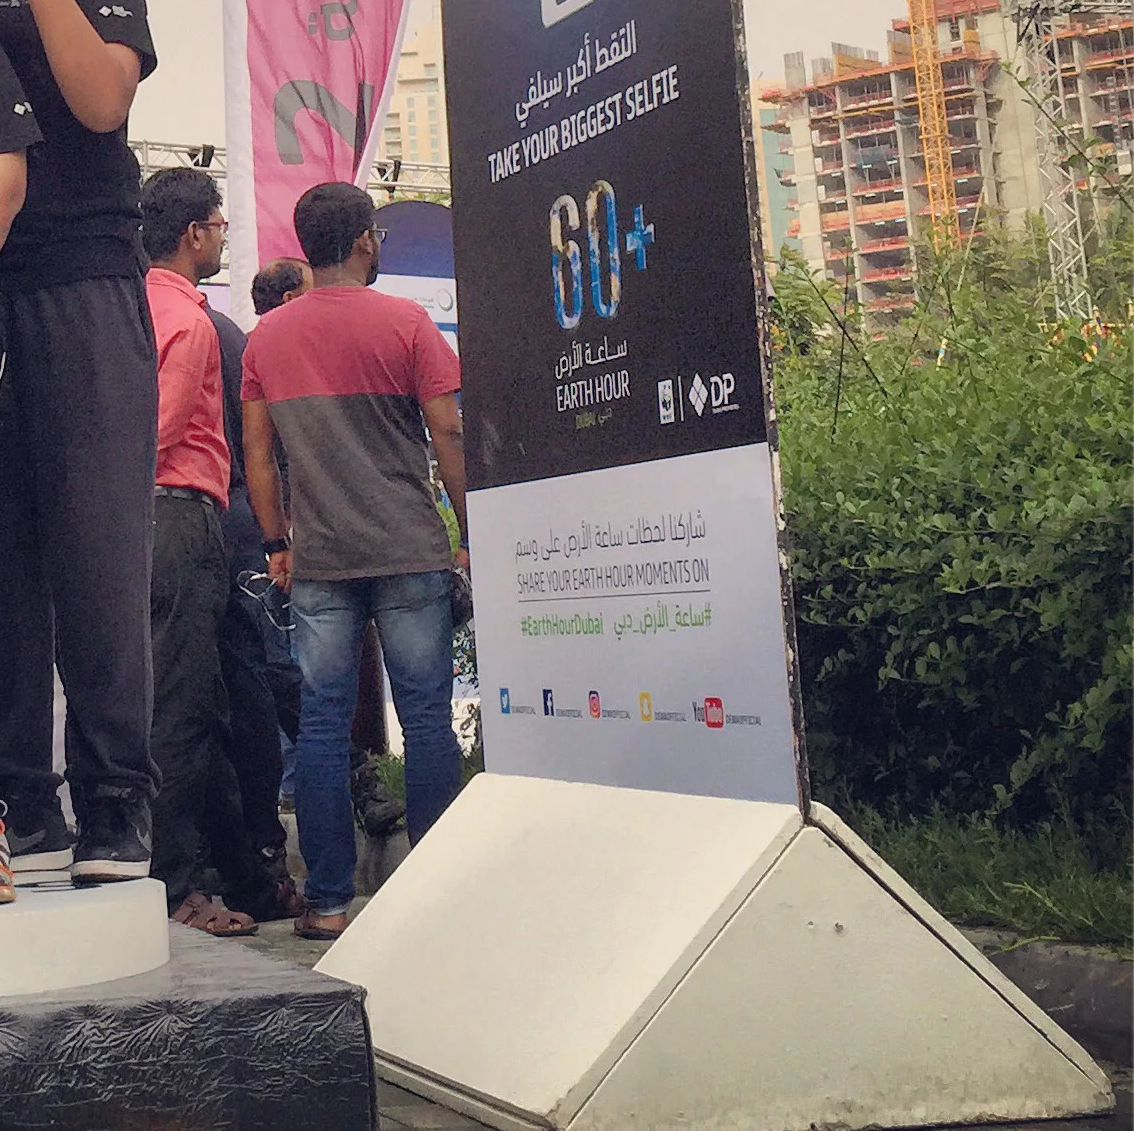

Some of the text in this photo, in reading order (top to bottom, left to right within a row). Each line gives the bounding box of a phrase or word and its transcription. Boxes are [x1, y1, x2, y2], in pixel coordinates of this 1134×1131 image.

[516, 19, 638, 128] التقط أكبر سيلفي
[488, 65, 680, 183] TAKE YOUR BIGGEST SELFIE
[555, 340, 583, 380] الأرض
[556, 370, 631, 412] EARTH HOUR
[709, 372, 735, 407] DP
[516, 509, 706, 563] شاركنا لحظات ساعة الأرض على وسم
[517, 558, 710, 594] SHARE YOUR EARTH HOUR MOMENTS ON
[521, 612, 604, 637] #EarthHourDubai
